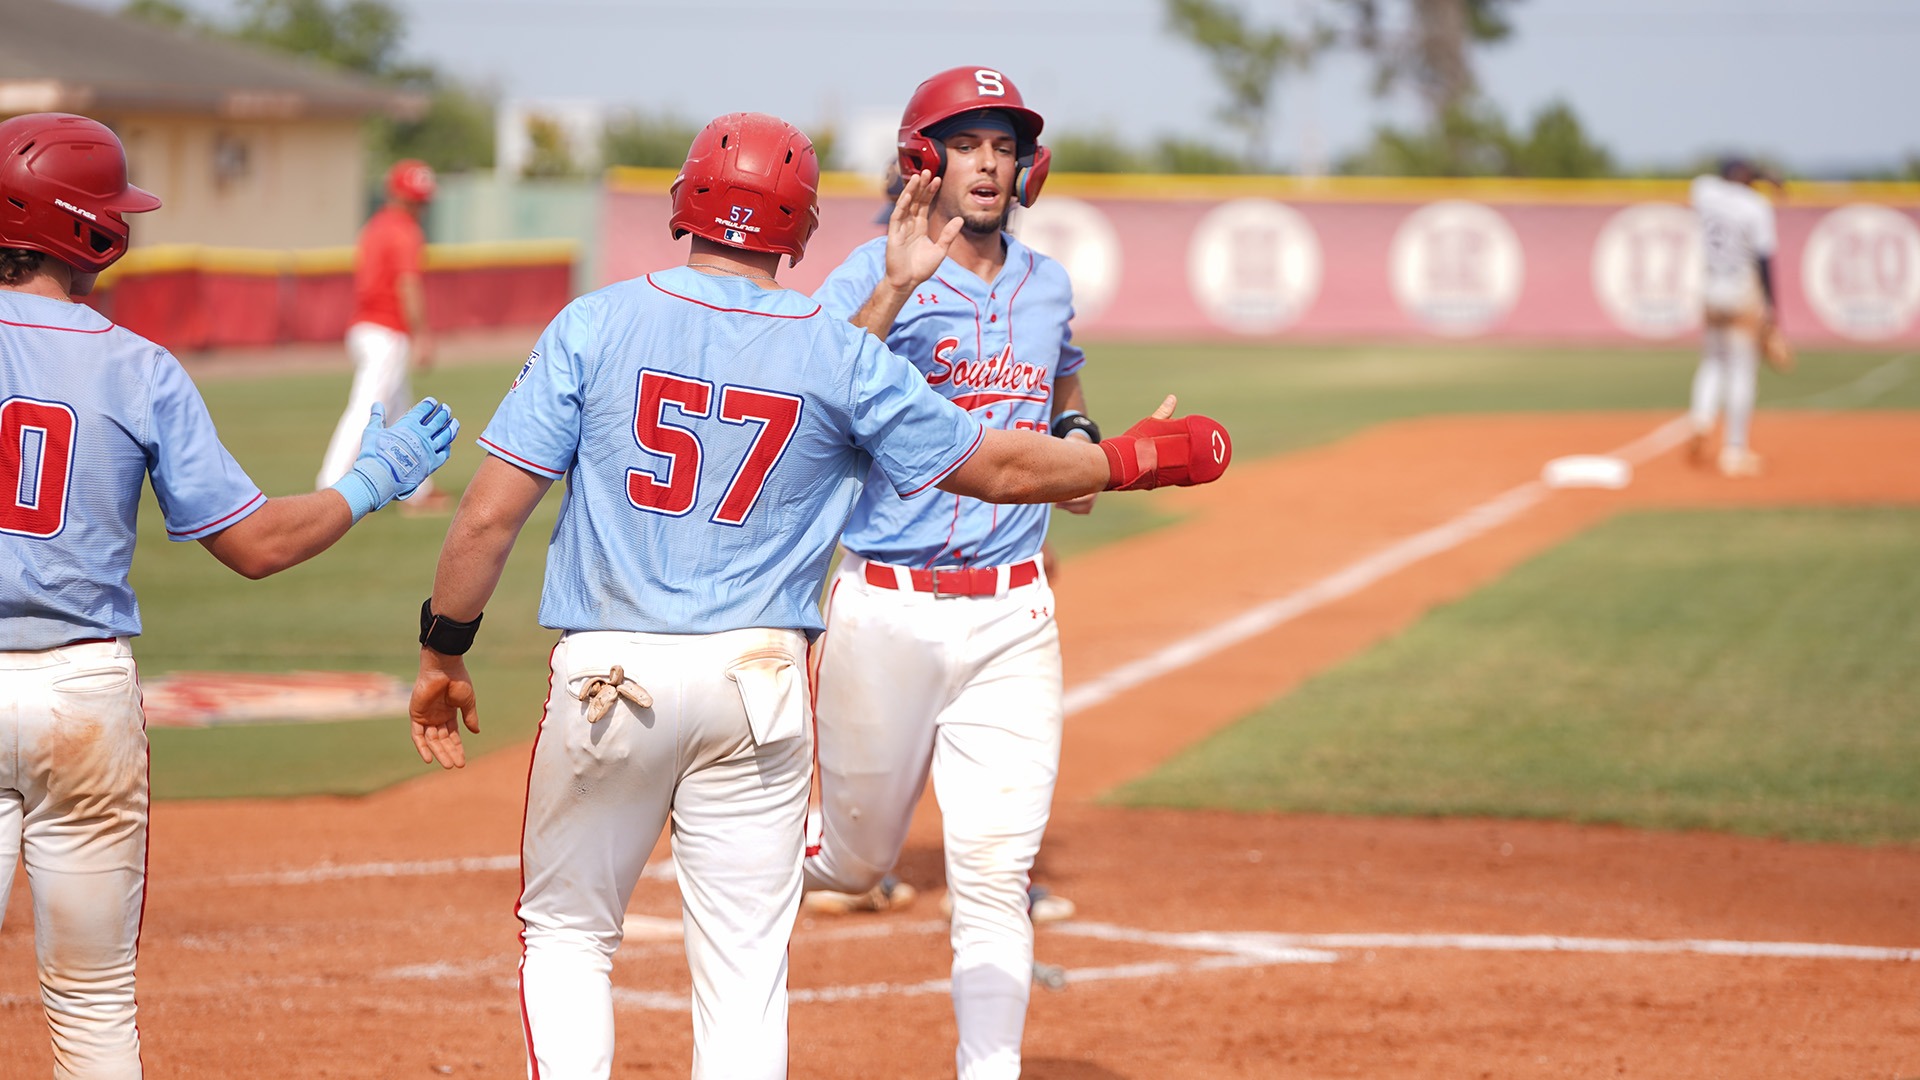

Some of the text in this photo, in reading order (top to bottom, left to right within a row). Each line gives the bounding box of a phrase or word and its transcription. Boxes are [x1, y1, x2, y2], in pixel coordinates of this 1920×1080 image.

[974, 69, 1005, 97] S
[54, 198, 97, 222] RAWLINGS
[729, 204, 754, 224] 57
[714, 216, 761, 233] RAWLINGS
[925, 336, 1050, 394] Southern
[624, 367, 804, 527] 57
